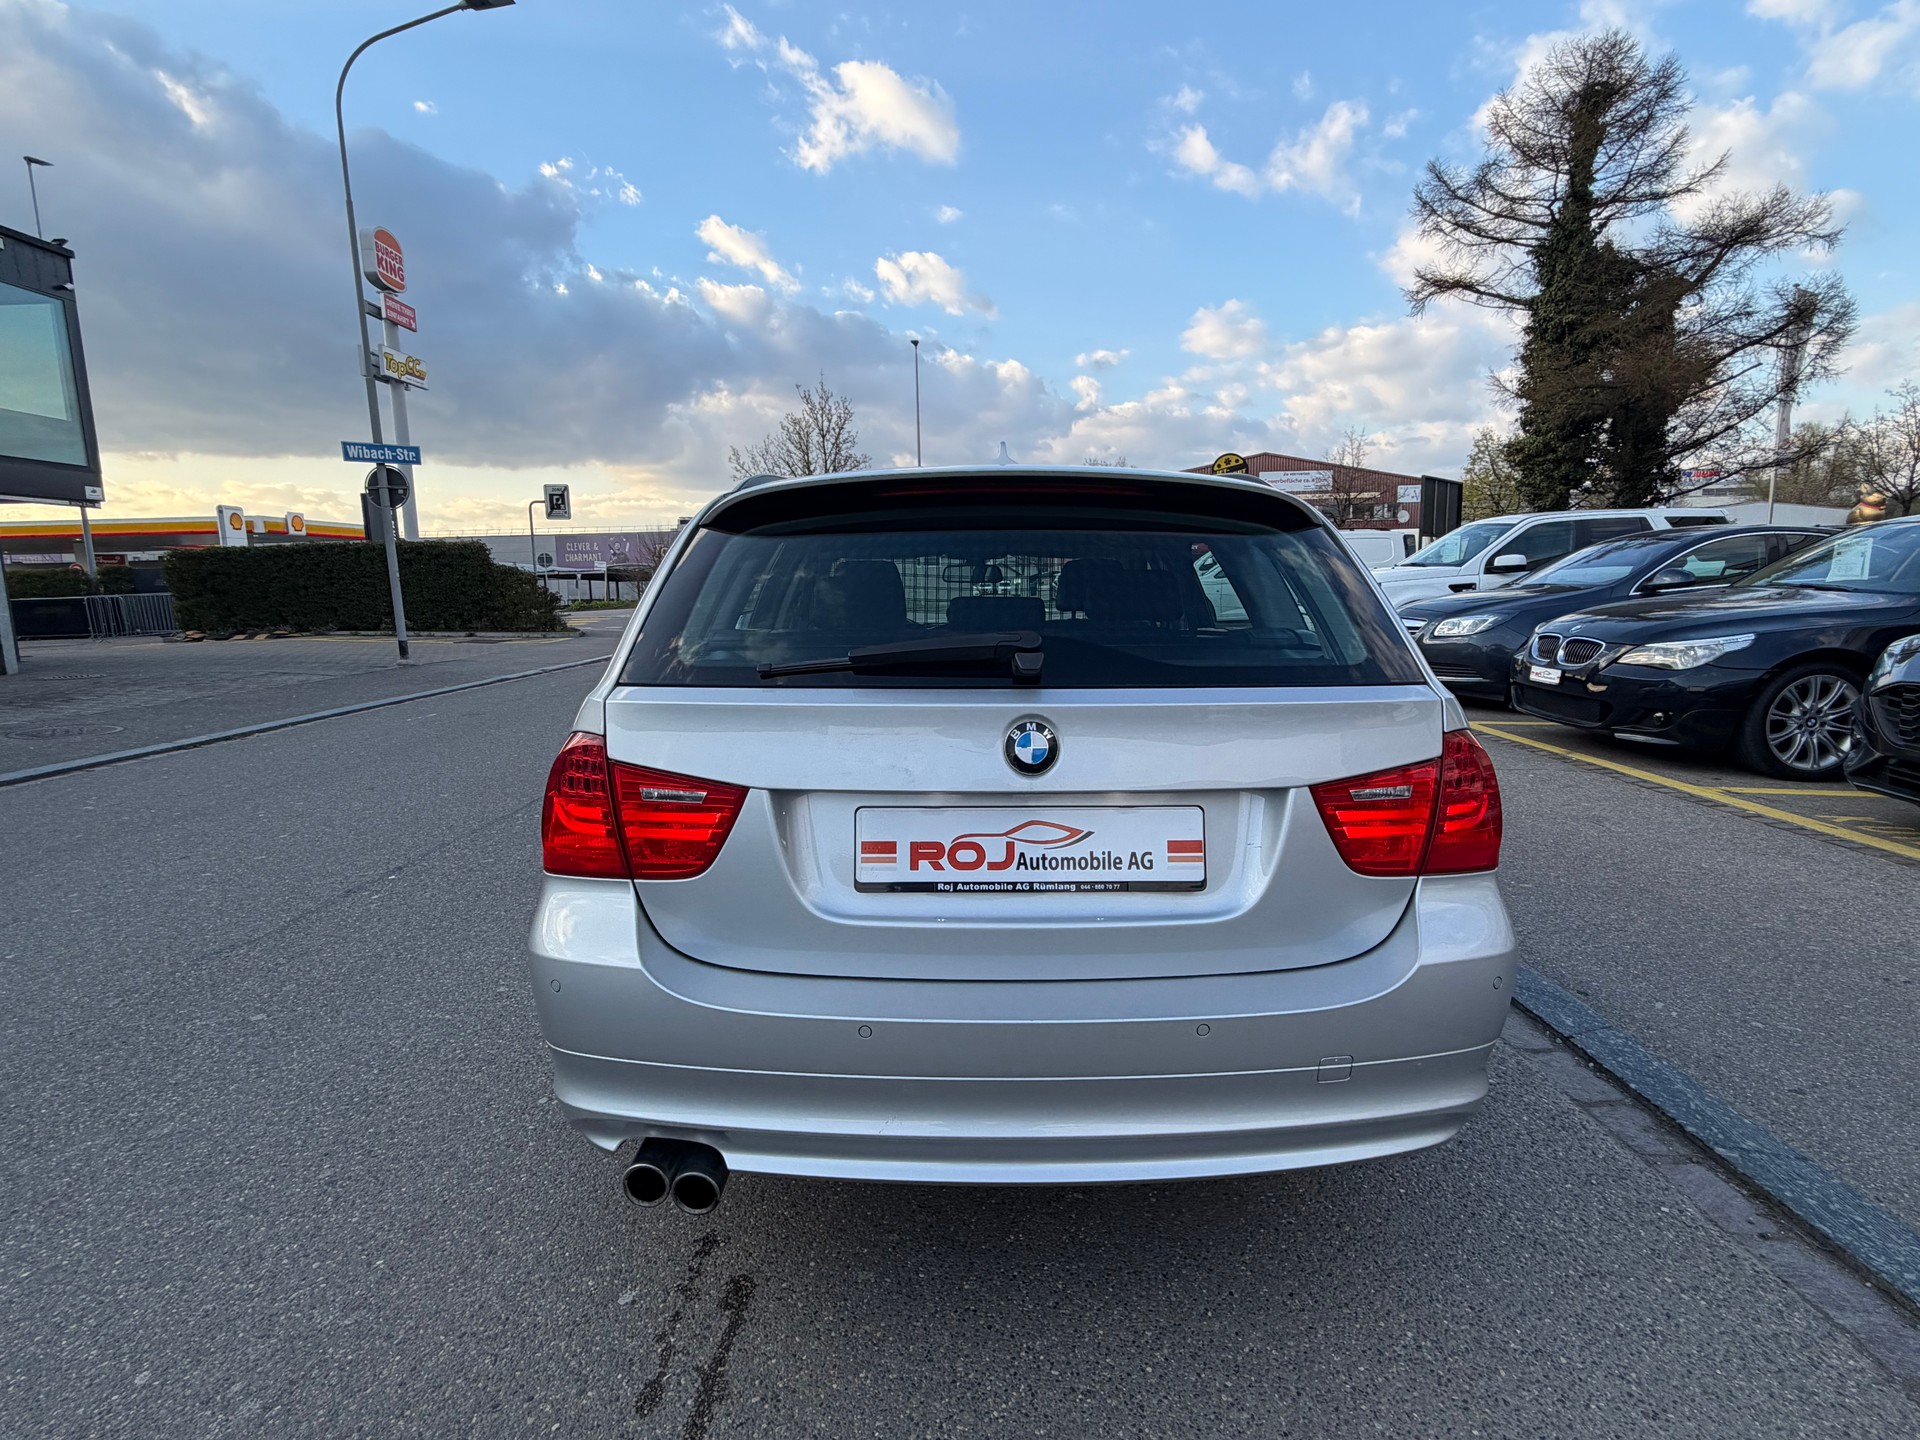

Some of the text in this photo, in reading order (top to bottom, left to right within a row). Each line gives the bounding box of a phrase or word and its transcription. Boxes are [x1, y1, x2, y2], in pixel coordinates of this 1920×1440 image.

[374, 240, 404, 268] BURGER
[376, 252, 405, 283] KING
[346, 444, 417, 462] Wibach-Str.
[566, 542, 600, 552] CLEVER &
[565, 552, 602, 563] CHARMANT
[1010, 722, 1054, 740] BMW
[909, 840, 1015, 871] ROJ
[1016, 850, 1154, 871] Automobile AG
[937, 882, 954, 892] Roj
[957, 882, 1013, 891] Automobile
[1016, 882, 1030, 891] AG
[1033, 881, 1076, 892] Rümlang
